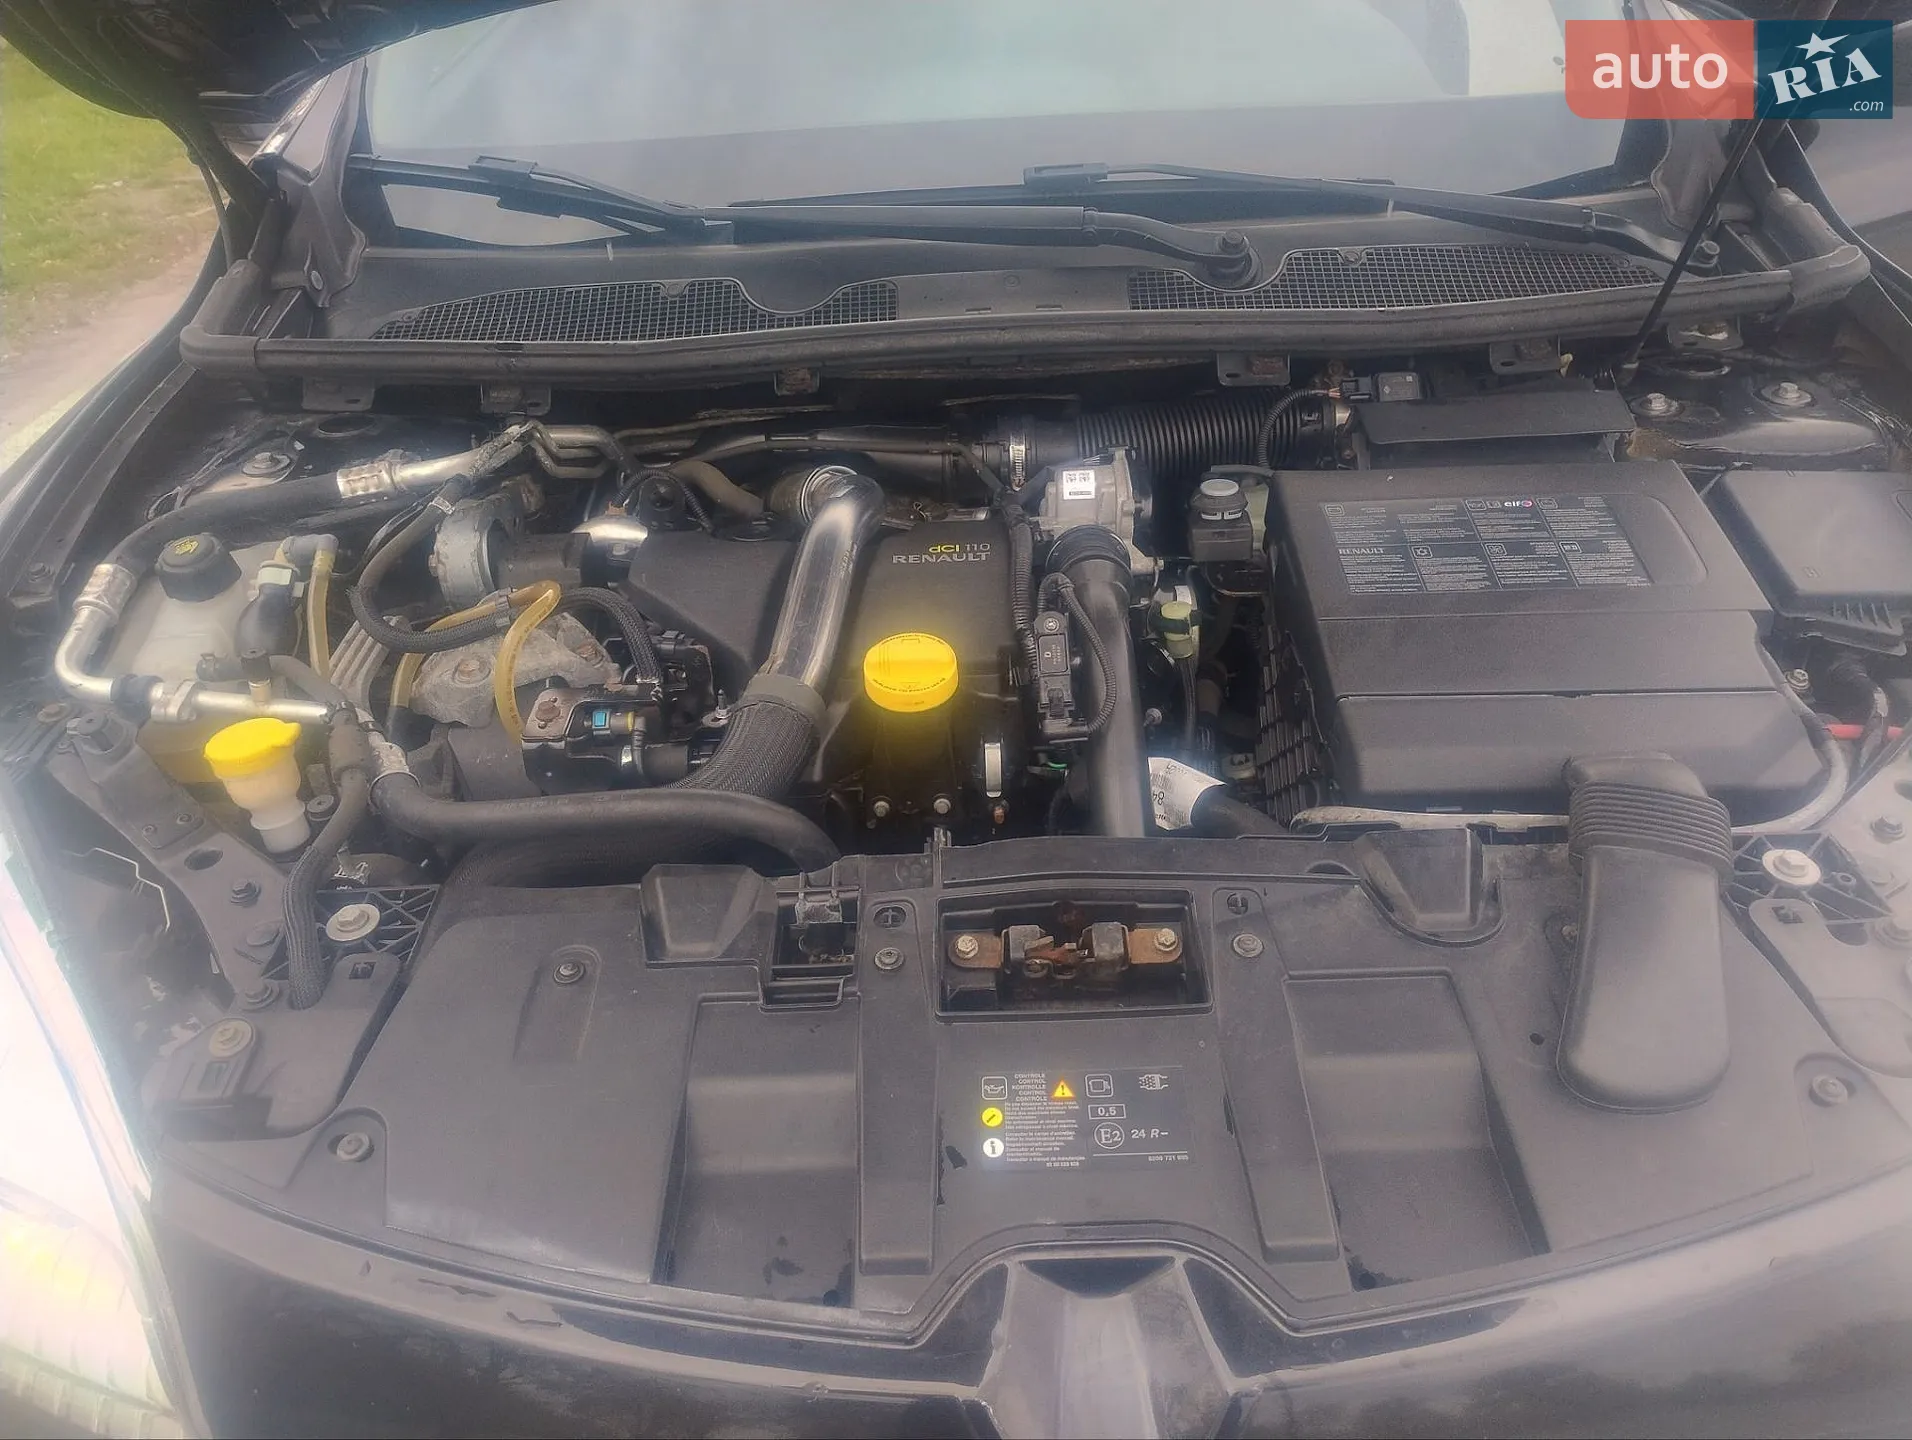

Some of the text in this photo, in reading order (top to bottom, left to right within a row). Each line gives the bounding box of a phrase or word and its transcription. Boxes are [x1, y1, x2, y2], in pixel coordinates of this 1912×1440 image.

[964, 543, 991, 551] 110
[891, 552, 991, 564] RENAULT
[1097, 1106, 1117, 1117] 0,5
[1099, 1128, 1122, 1144] E2
[1130, 1128, 1146, 1139] 24
